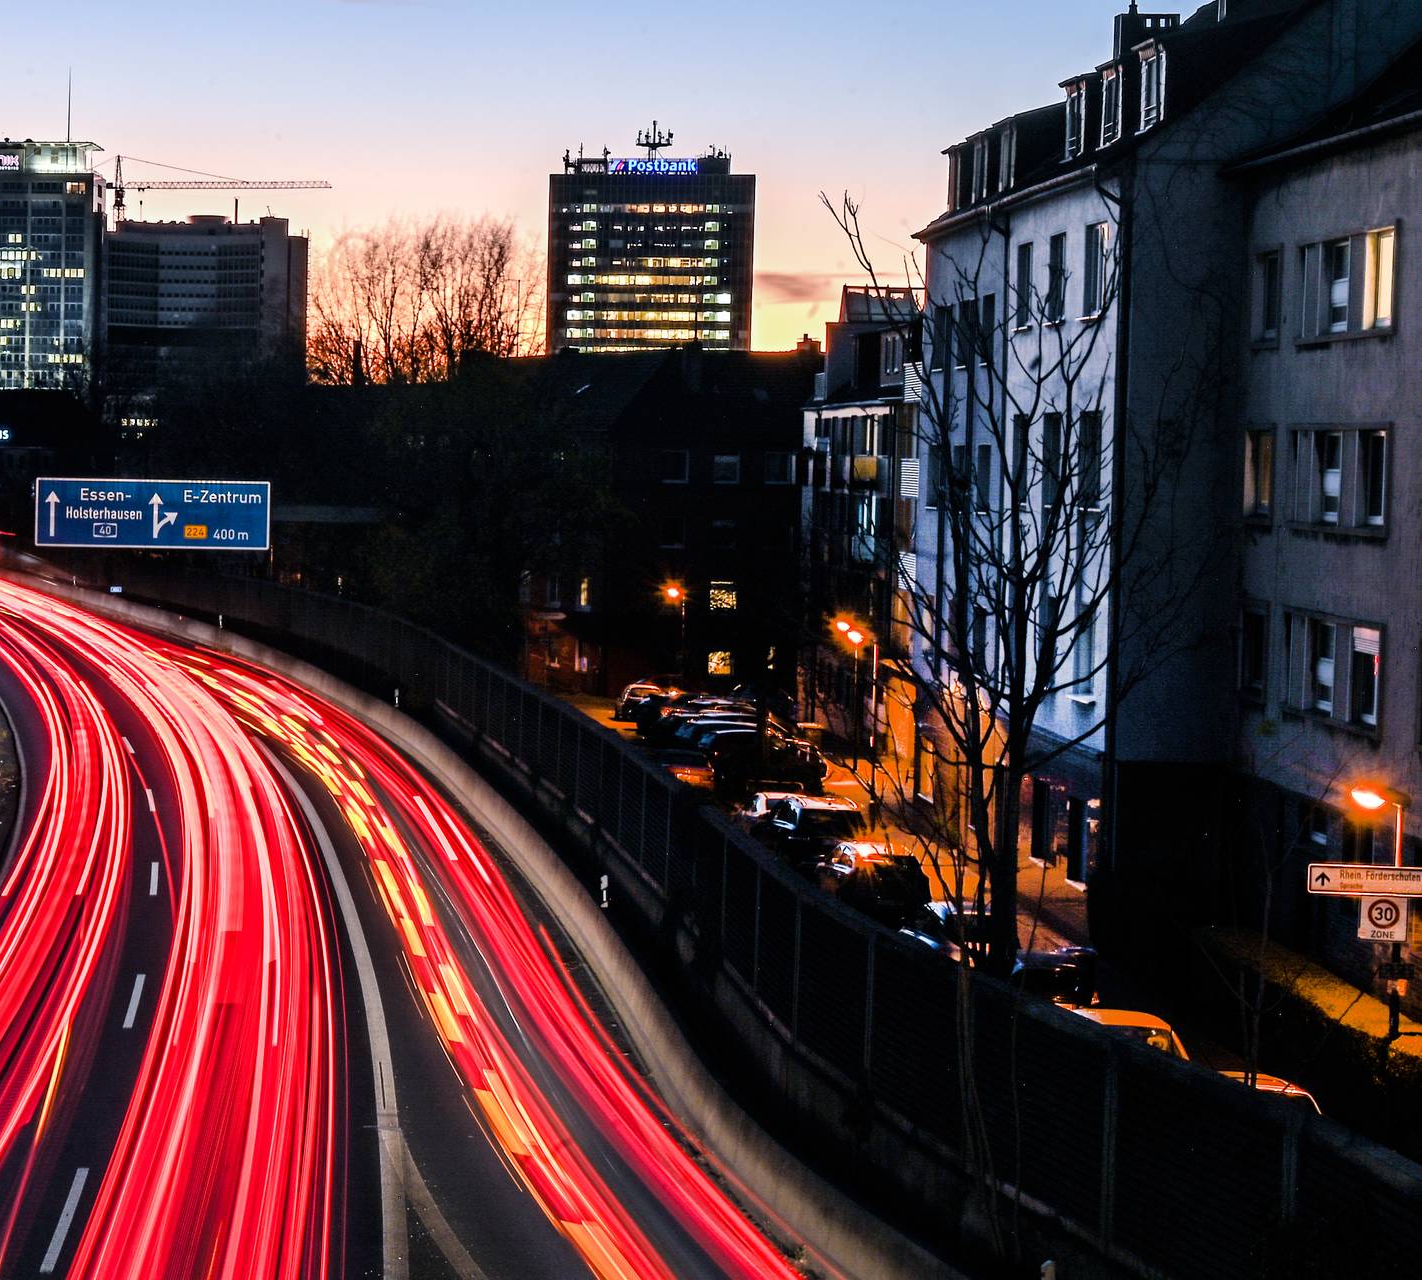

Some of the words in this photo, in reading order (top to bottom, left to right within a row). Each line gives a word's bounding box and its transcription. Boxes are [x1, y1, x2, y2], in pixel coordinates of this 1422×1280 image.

[629, 160, 696, 172] Postbank
[80, 488, 131, 501] Essen-
[184, 490, 262, 504] E-Zentrum
[66, 506, 143, 520] Holsterhausen
[99, 526, 112, 536] 40
[186, 527, 205, 537] 224
[213, 529, 234, 540] 400
[237, 531, 249, 540] m
[1339, 869, 1364, 880] Rhein.
[1374, 907, 1393, 922] 30
[1370, 930, 1395, 939] ZONE
